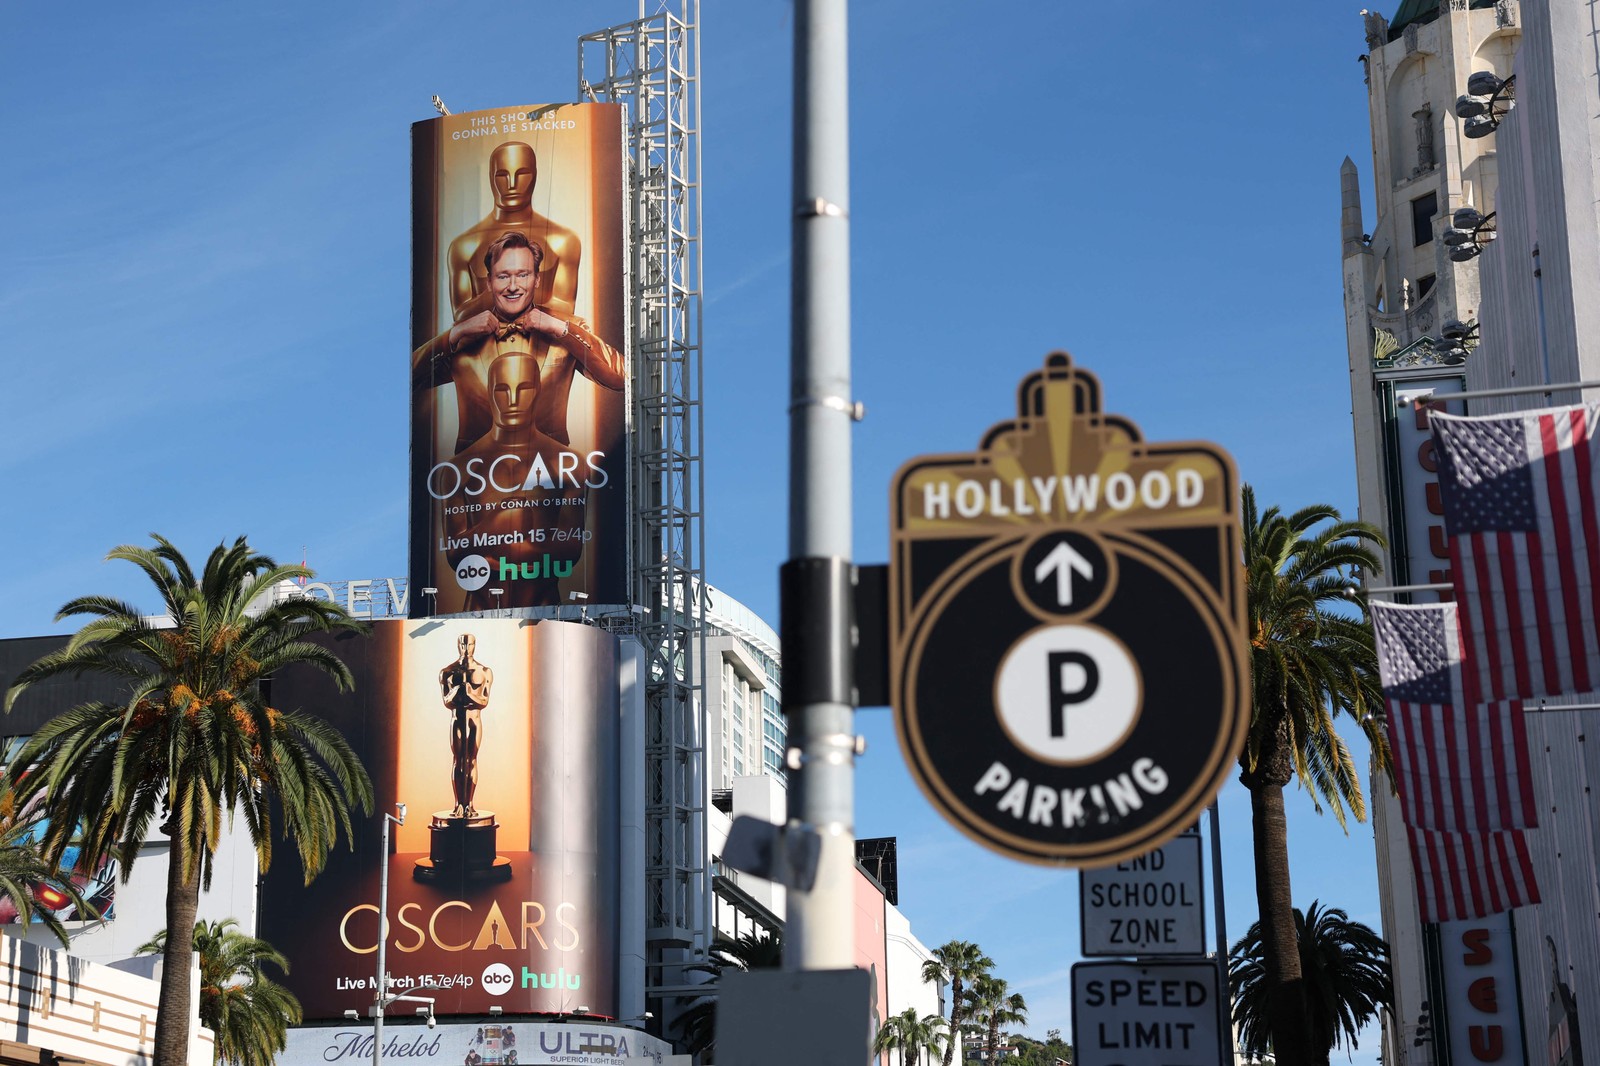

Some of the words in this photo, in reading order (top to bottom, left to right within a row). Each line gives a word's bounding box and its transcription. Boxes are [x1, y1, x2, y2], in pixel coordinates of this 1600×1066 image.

[452, 126, 498, 140] GONNA
[503, 123, 517, 134] BE
[521, 120, 576, 131] STACKED
[471, 115, 496, 127] THIS
[500, 111, 539, 123] SHOW
[543, 110, 555, 119] IS
[426, 451, 609, 500] OSCARS
[444, 502, 482, 515] HOSTED
[485, 502, 497, 511] BY
[500, 498, 539, 509] CONAN
[543, 497, 586, 507] O'BRIEN
[922, 469, 1205, 520] HOLLYWOOD
[439, 535, 470, 552] Live
[473, 530, 524, 547] March
[528, 529, 546, 543] 15
[550, 528, 593, 547] 7e/4p
[457, 565, 488, 579] abc
[499, 553, 573, 581] hulu
[1046, 649, 1100, 739] P
[973, 756, 1169, 828] PARKING
[1091, 882, 1194, 908] SCHOOL
[339, 900, 580, 954] OSCARS
[1110, 919, 1177, 944] ZONE
[336, 977, 366, 990] Live
[369, 975, 414, 988] Mrch
[437, 973, 474, 989] 7e/4p
[482, 972, 512, 985] abc
[521, 966, 581, 990] hulu
[1085, 980, 1208, 1008] SPEED
[323, 1032, 442, 1062] Mihelob
[539, 1031, 630, 1058] ULTRA
[1099, 1021, 1195, 1049] LIMIT
[550, 1055, 589, 1064] SUPERIOR
[590, 1057, 610, 1065] LIGHT
[610, 1058, 625, 1066] BEER
